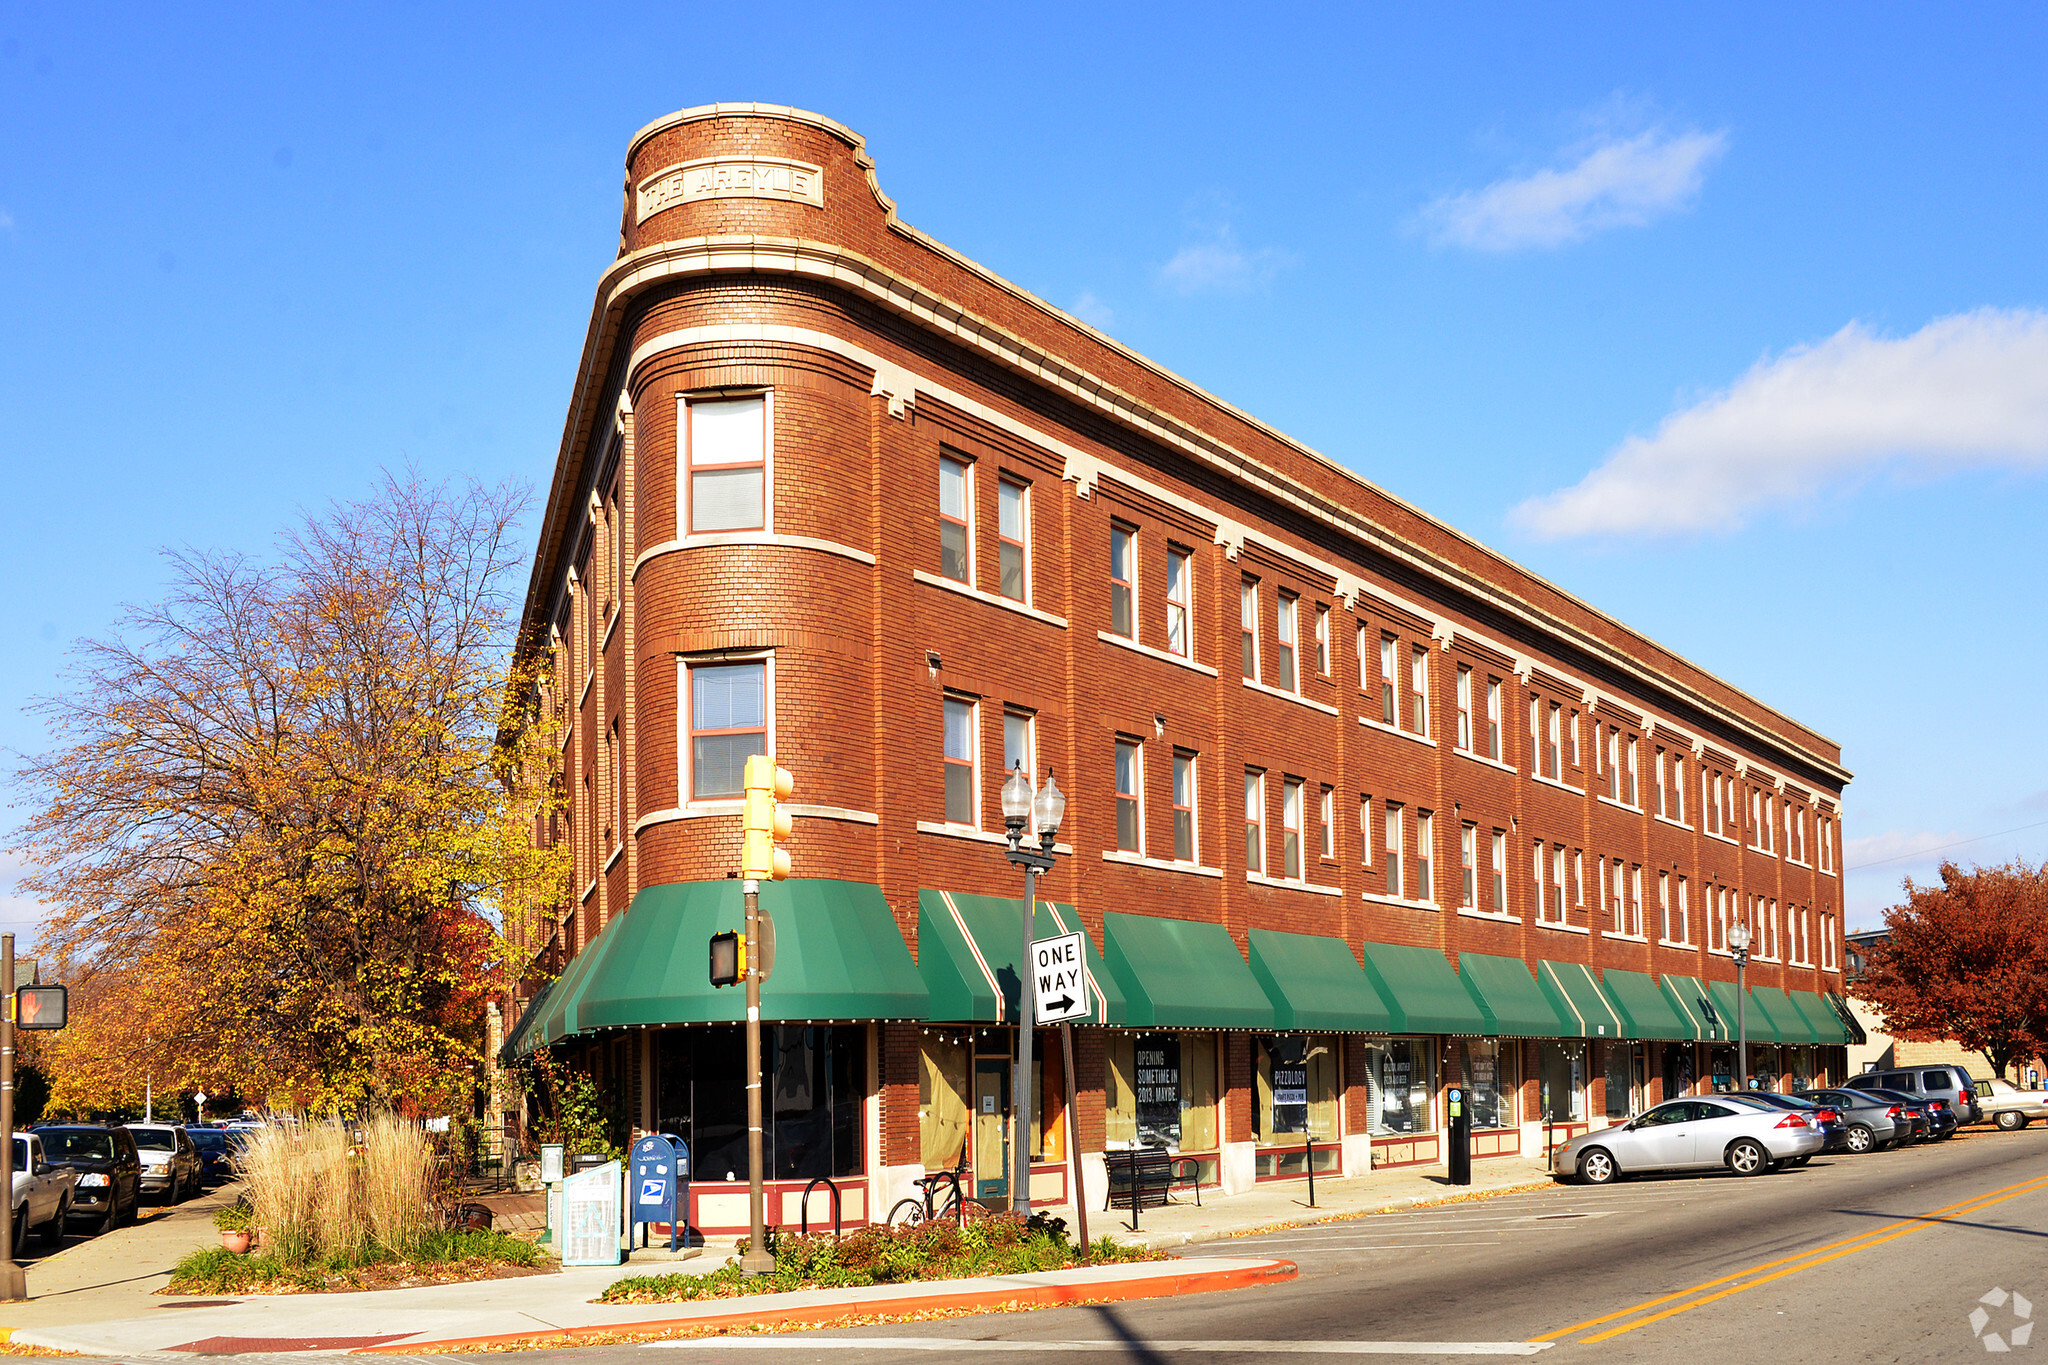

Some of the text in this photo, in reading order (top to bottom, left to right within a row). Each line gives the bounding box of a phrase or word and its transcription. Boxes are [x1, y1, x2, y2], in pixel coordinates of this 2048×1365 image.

[646, 166, 809, 210] THE ARGYLE
[1039, 943, 1075, 967] ONE
[1039, 969, 1077, 993] WAY
[1137, 1050, 1165, 1066] OPENING
[1137, 1068, 1178, 1084] SOMETIME IN
[1274, 1070, 1306, 1085] PIZZOLOGY
[1155, 1086, 1178, 1102] MAYBE.
